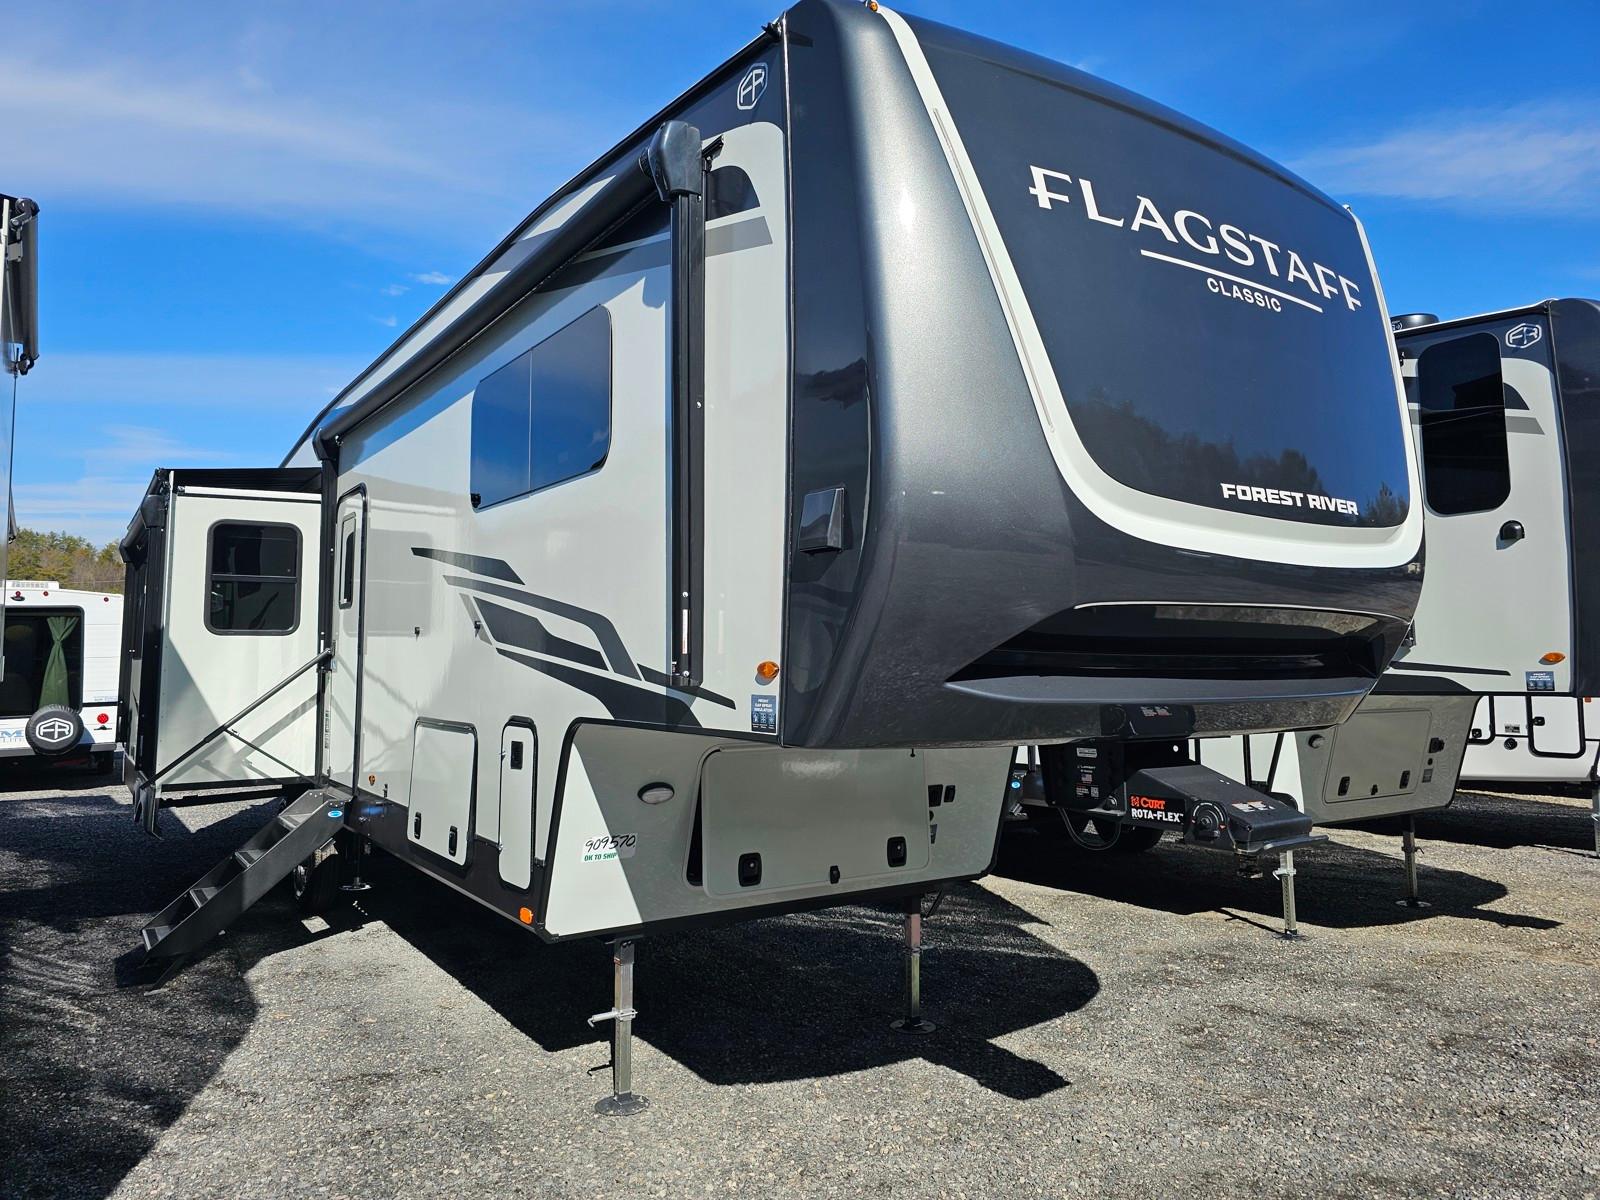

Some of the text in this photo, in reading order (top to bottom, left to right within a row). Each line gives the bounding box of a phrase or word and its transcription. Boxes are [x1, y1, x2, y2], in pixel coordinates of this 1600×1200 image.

[1029, 165, 1362, 311] FLAGSTAFF
[1206, 277, 1282, 313] CLASSIC
[1220, 482, 1359, 515] FOREST RIVER
